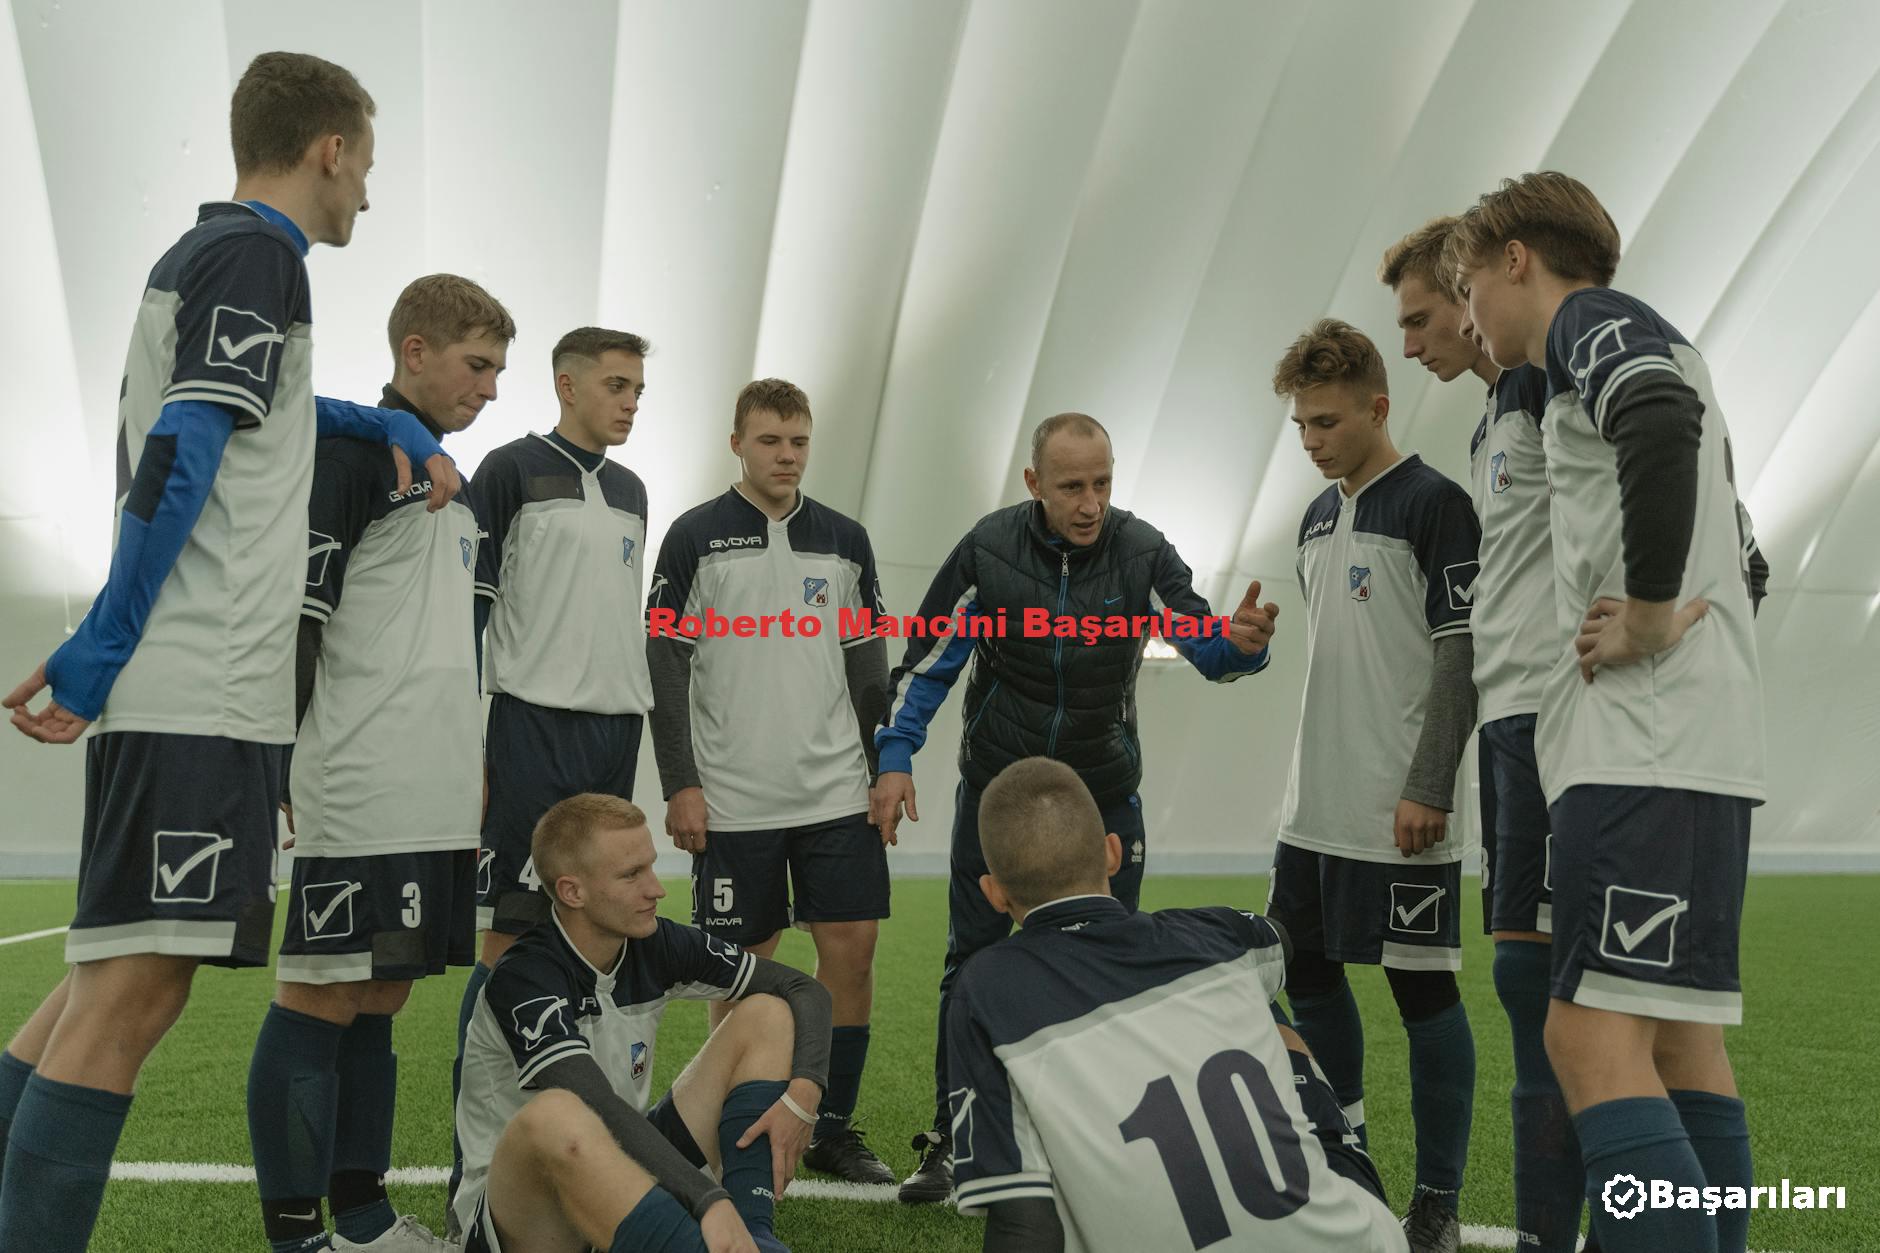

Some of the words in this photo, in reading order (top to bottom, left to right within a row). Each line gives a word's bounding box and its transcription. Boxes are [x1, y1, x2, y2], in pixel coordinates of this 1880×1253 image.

[518, 855, 542, 892] 4
[402, 882, 422, 929] 3
[713, 878, 734, 913] 5
[1118, 1049, 1310, 1252] 10
